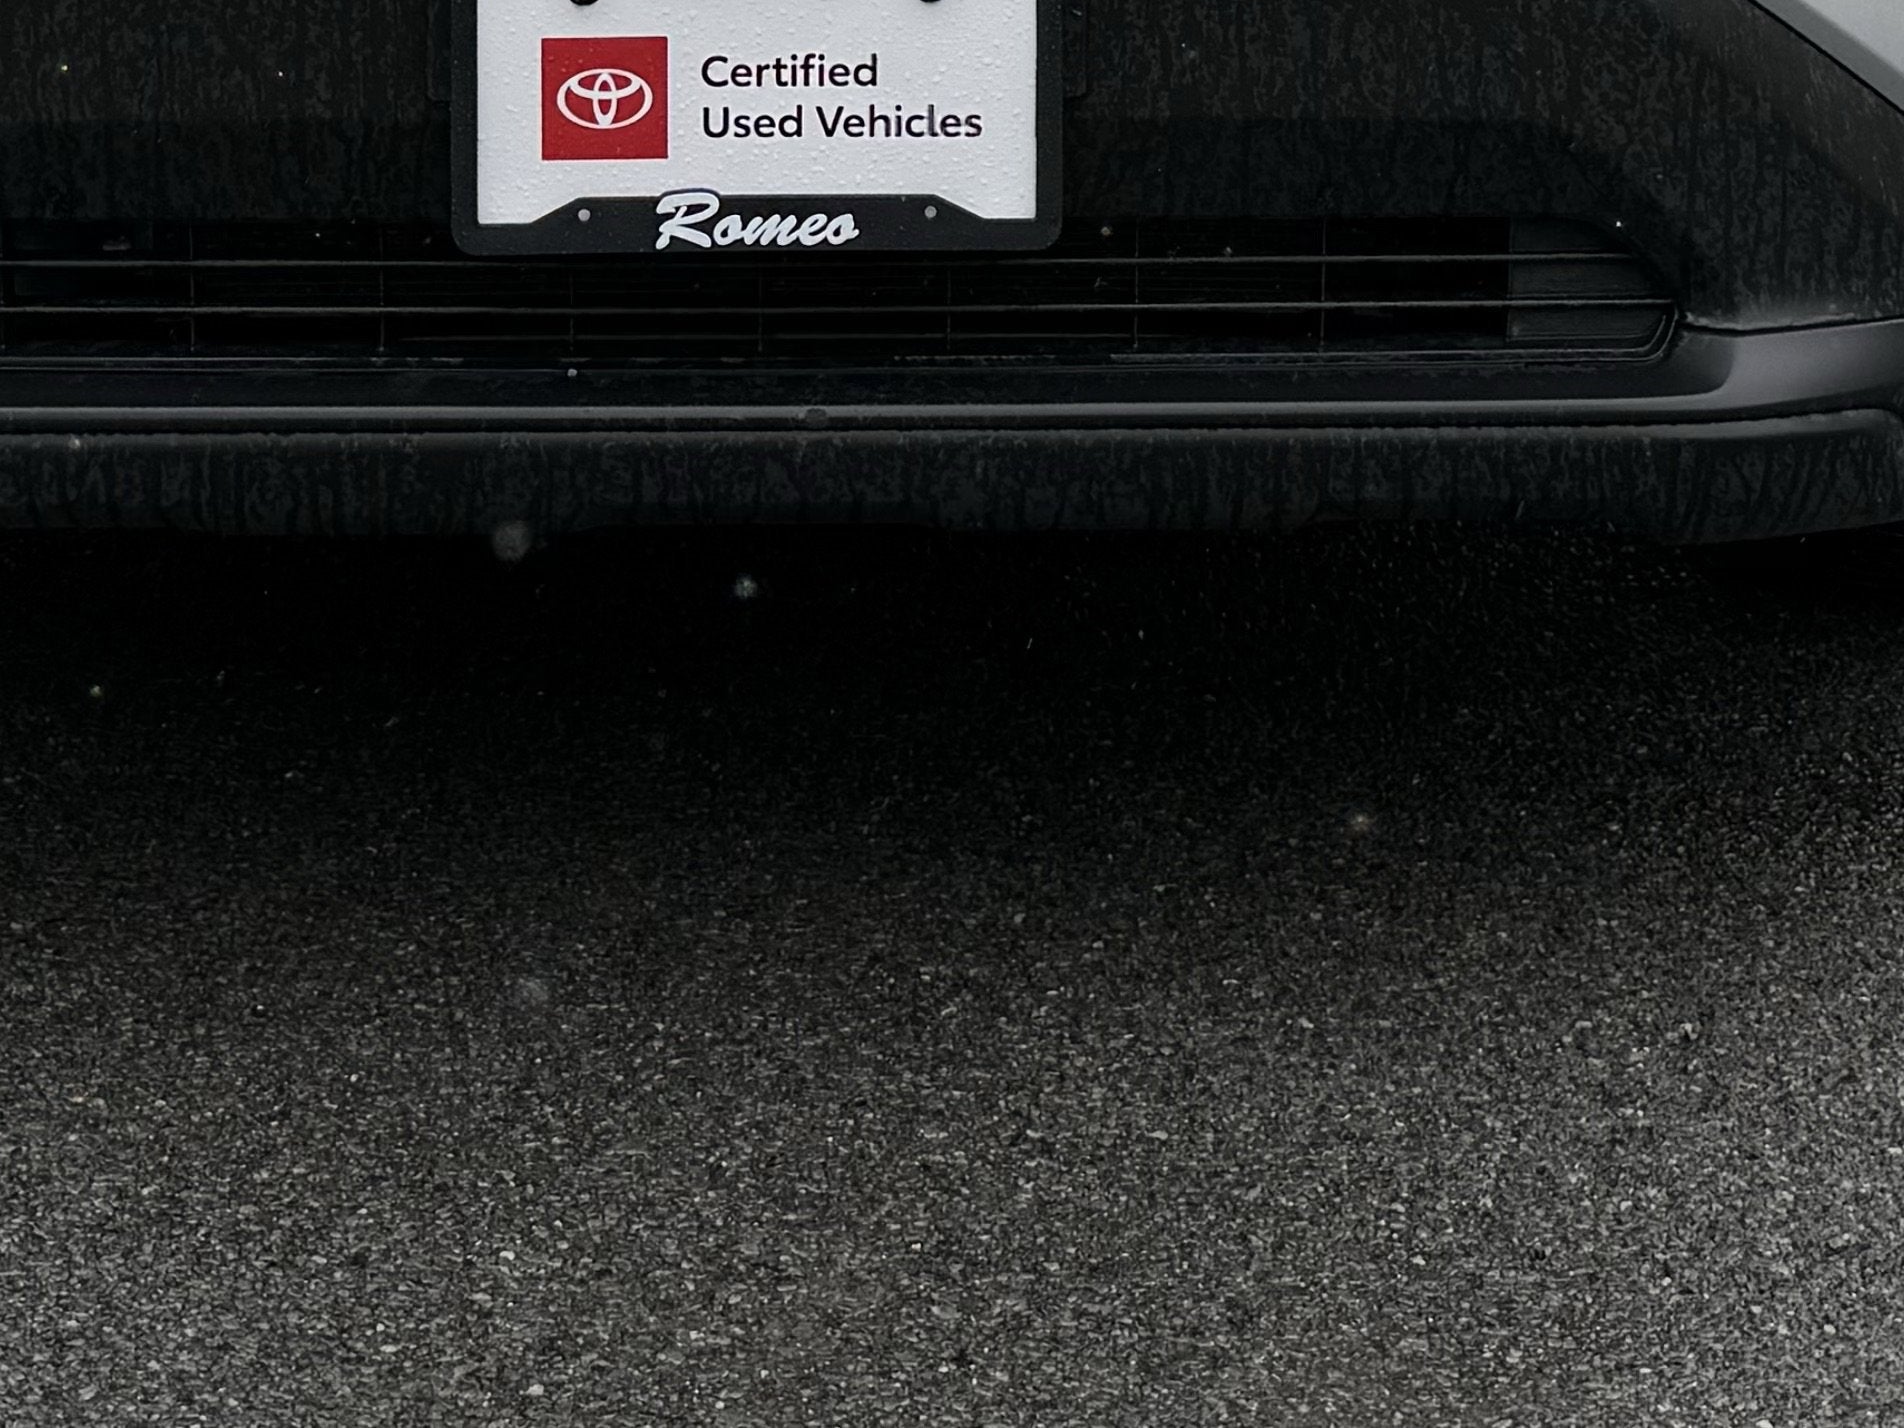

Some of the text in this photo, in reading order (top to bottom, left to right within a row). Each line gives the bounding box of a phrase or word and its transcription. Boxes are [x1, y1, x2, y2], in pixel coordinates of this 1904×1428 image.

[700, 53, 879, 88] Certified
[701, 104, 984, 139] Used Vehicles
[655, 192, 860, 250] Romeo
